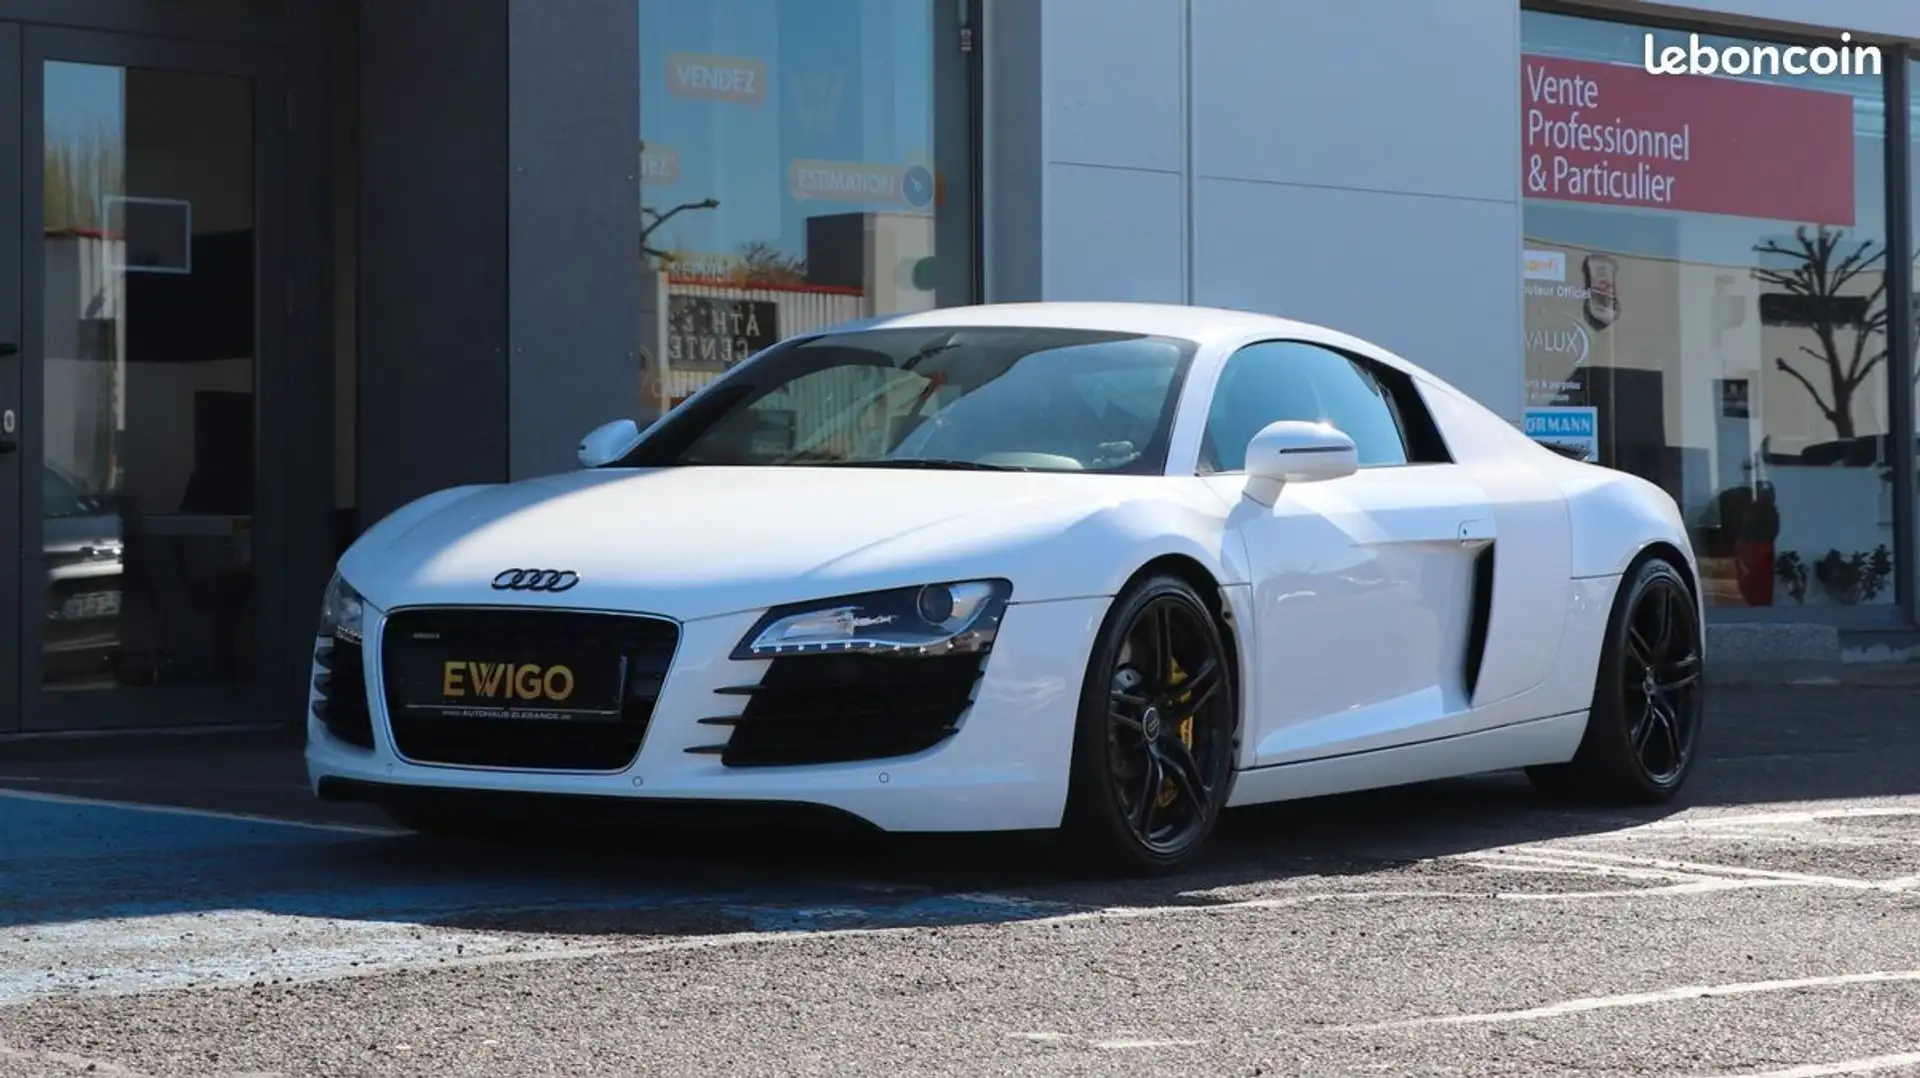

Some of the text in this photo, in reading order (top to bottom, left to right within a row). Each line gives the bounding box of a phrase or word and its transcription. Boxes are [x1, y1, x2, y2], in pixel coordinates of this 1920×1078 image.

[677, 64, 756, 94] VENDEZ
[1527, 64, 1600, 108] Vente
[1528, 109, 1691, 161] Professionnel
[797, 168, 896, 195] ESTIMATION
[1528, 154, 1675, 203] & Particulier
[443, 661, 575, 701] EWIGO
